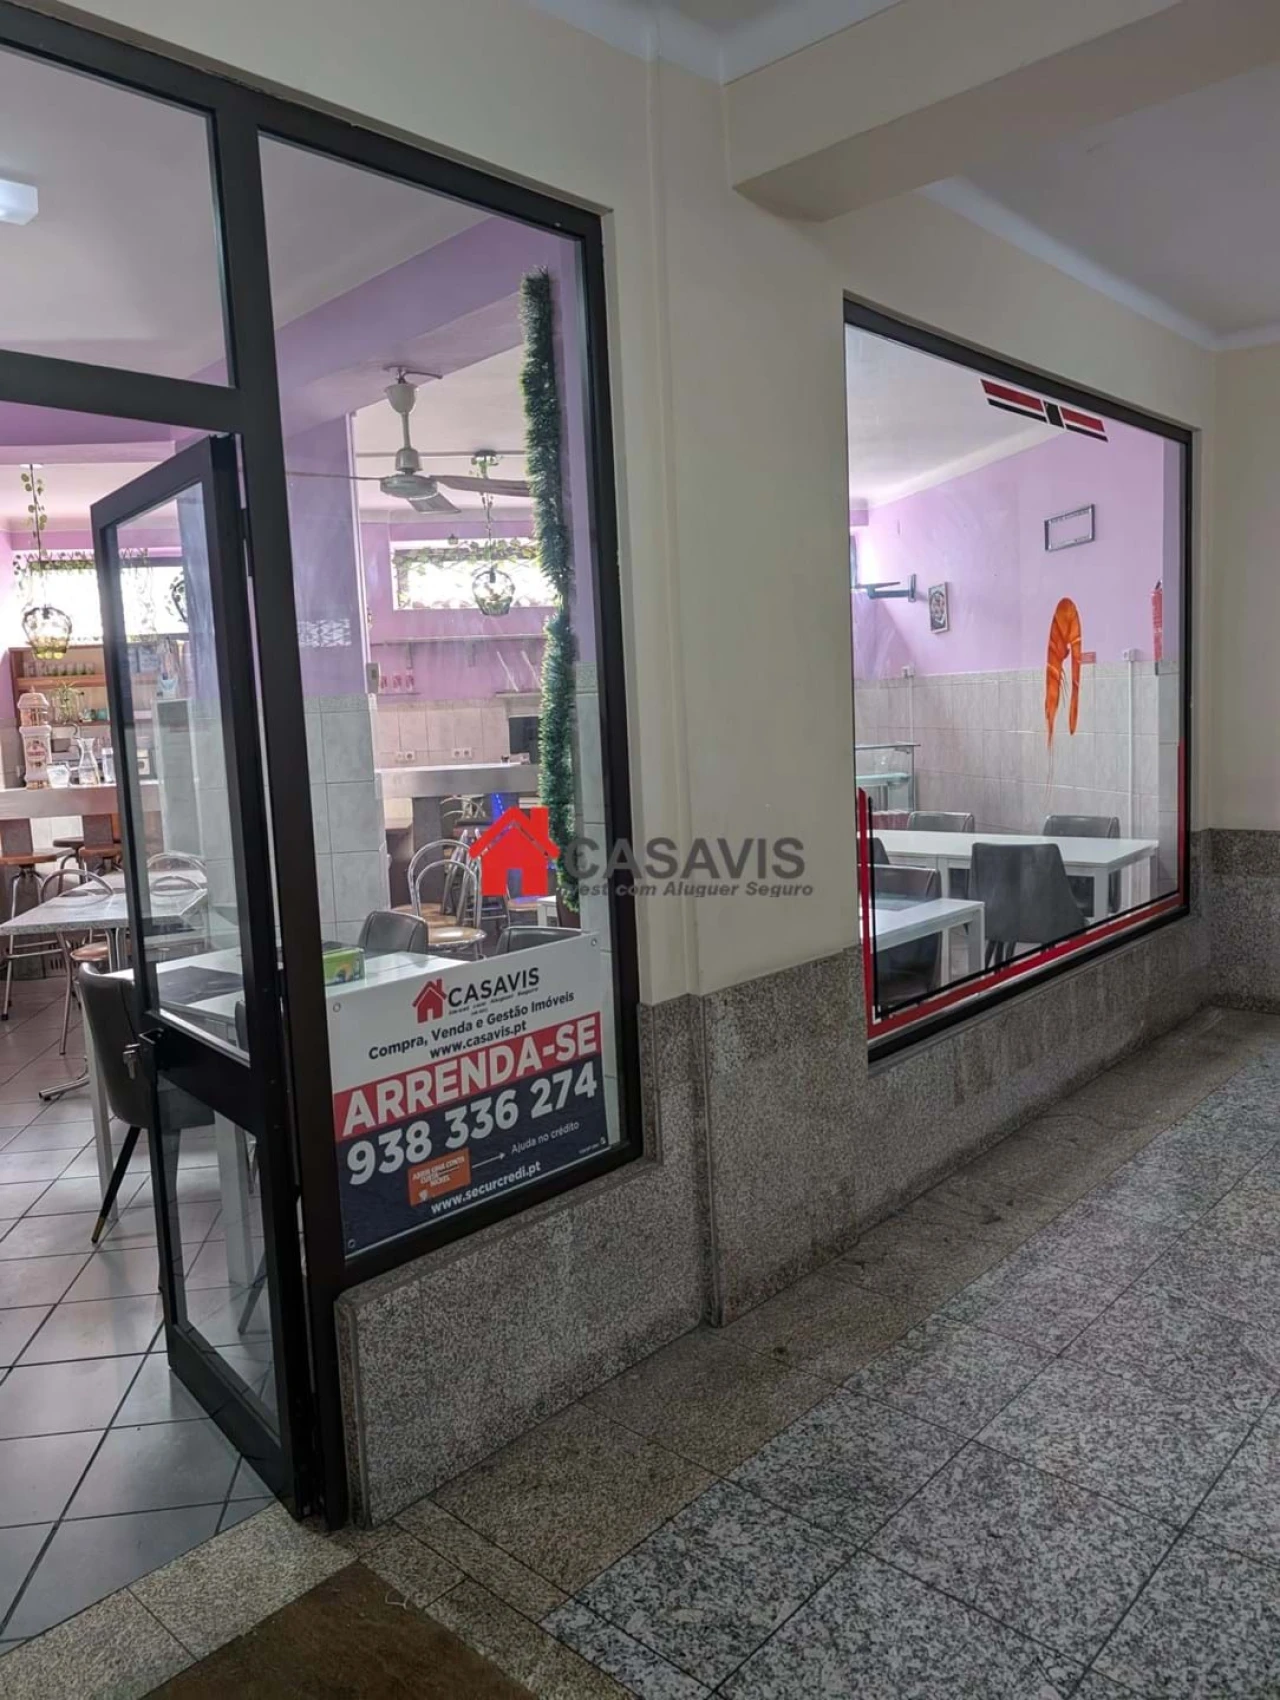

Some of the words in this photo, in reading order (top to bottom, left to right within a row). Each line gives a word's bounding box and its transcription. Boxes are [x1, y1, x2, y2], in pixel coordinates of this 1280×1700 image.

[448, 967, 540, 1008] CASAVIS
[368, 1035, 428, 1061] Compra,
[431, 1021, 473, 1043] Venda
[476, 1018, 484, 1029] e
[487, 1005, 529, 1026] Gestão
[531, 991, 575, 1015] Imóveis
[429, 1020, 527, 1059] www.casavis.pt
[342, 1015, 598, 1137] ARRENDA-SE
[347, 1120, 432, 1185] 938
[445, 1089, 519, 1150] 336
[530, 1062, 598, 1119] 274
[511, 1137, 537, 1155] Ajuda
[538, 1133, 549, 1143] no
[551, 1121, 580, 1141] crédito
[431, 1160, 541, 1215] www.securcredi.pt
